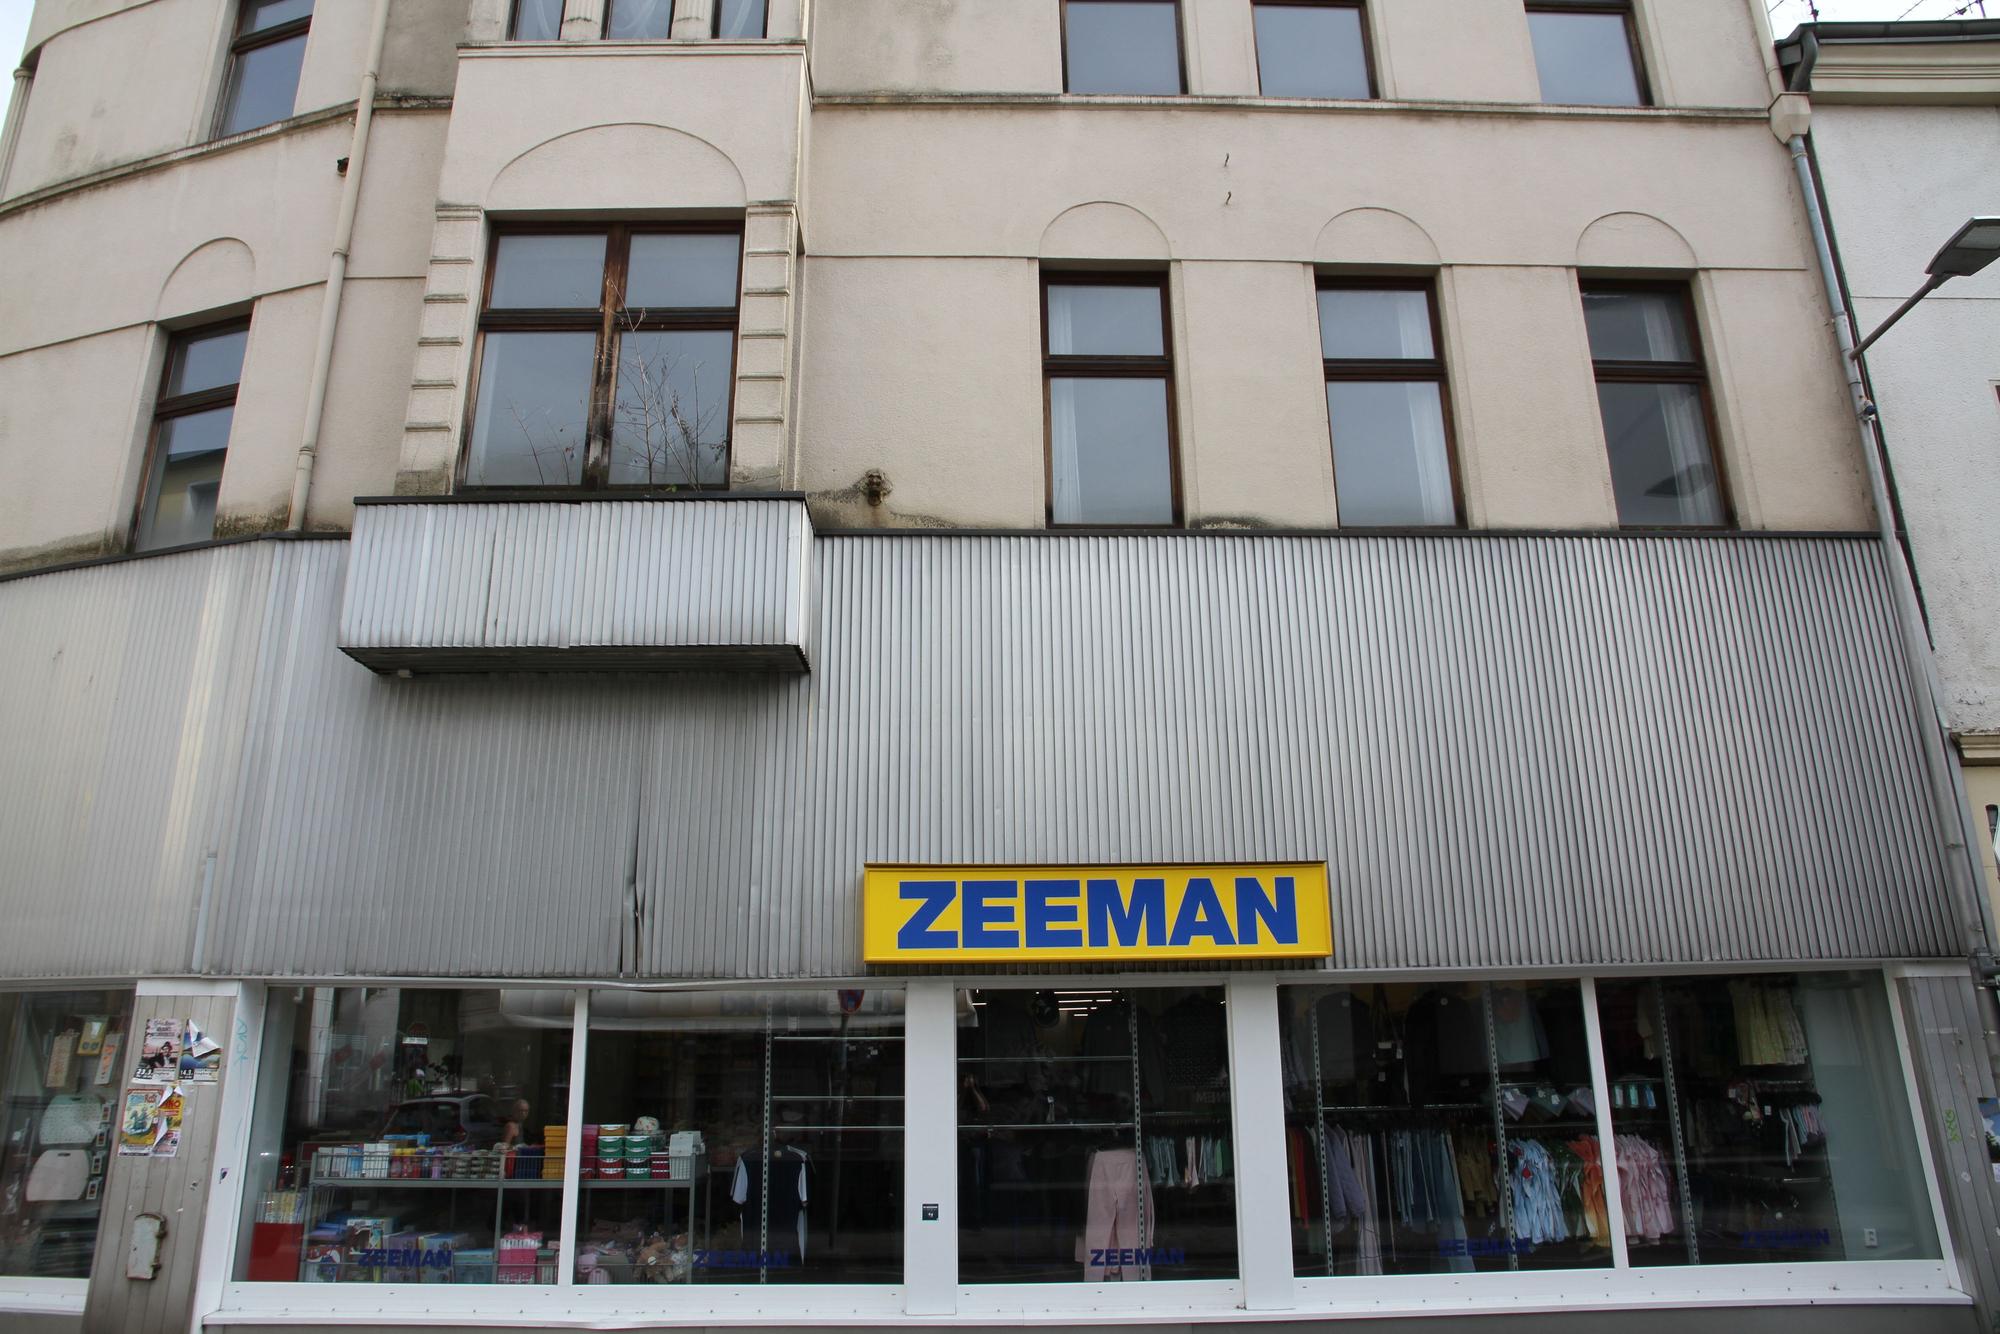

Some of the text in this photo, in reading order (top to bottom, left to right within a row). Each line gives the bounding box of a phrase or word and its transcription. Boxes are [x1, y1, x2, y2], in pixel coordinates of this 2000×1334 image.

[897, 876, 1299, 950] ZEEMAN
[358, 1249, 452, 1267] ZEEMAN
[693, 1249, 790, 1267] ZEEMAN
[1090, 1248, 1185, 1267] ZEEMAN
